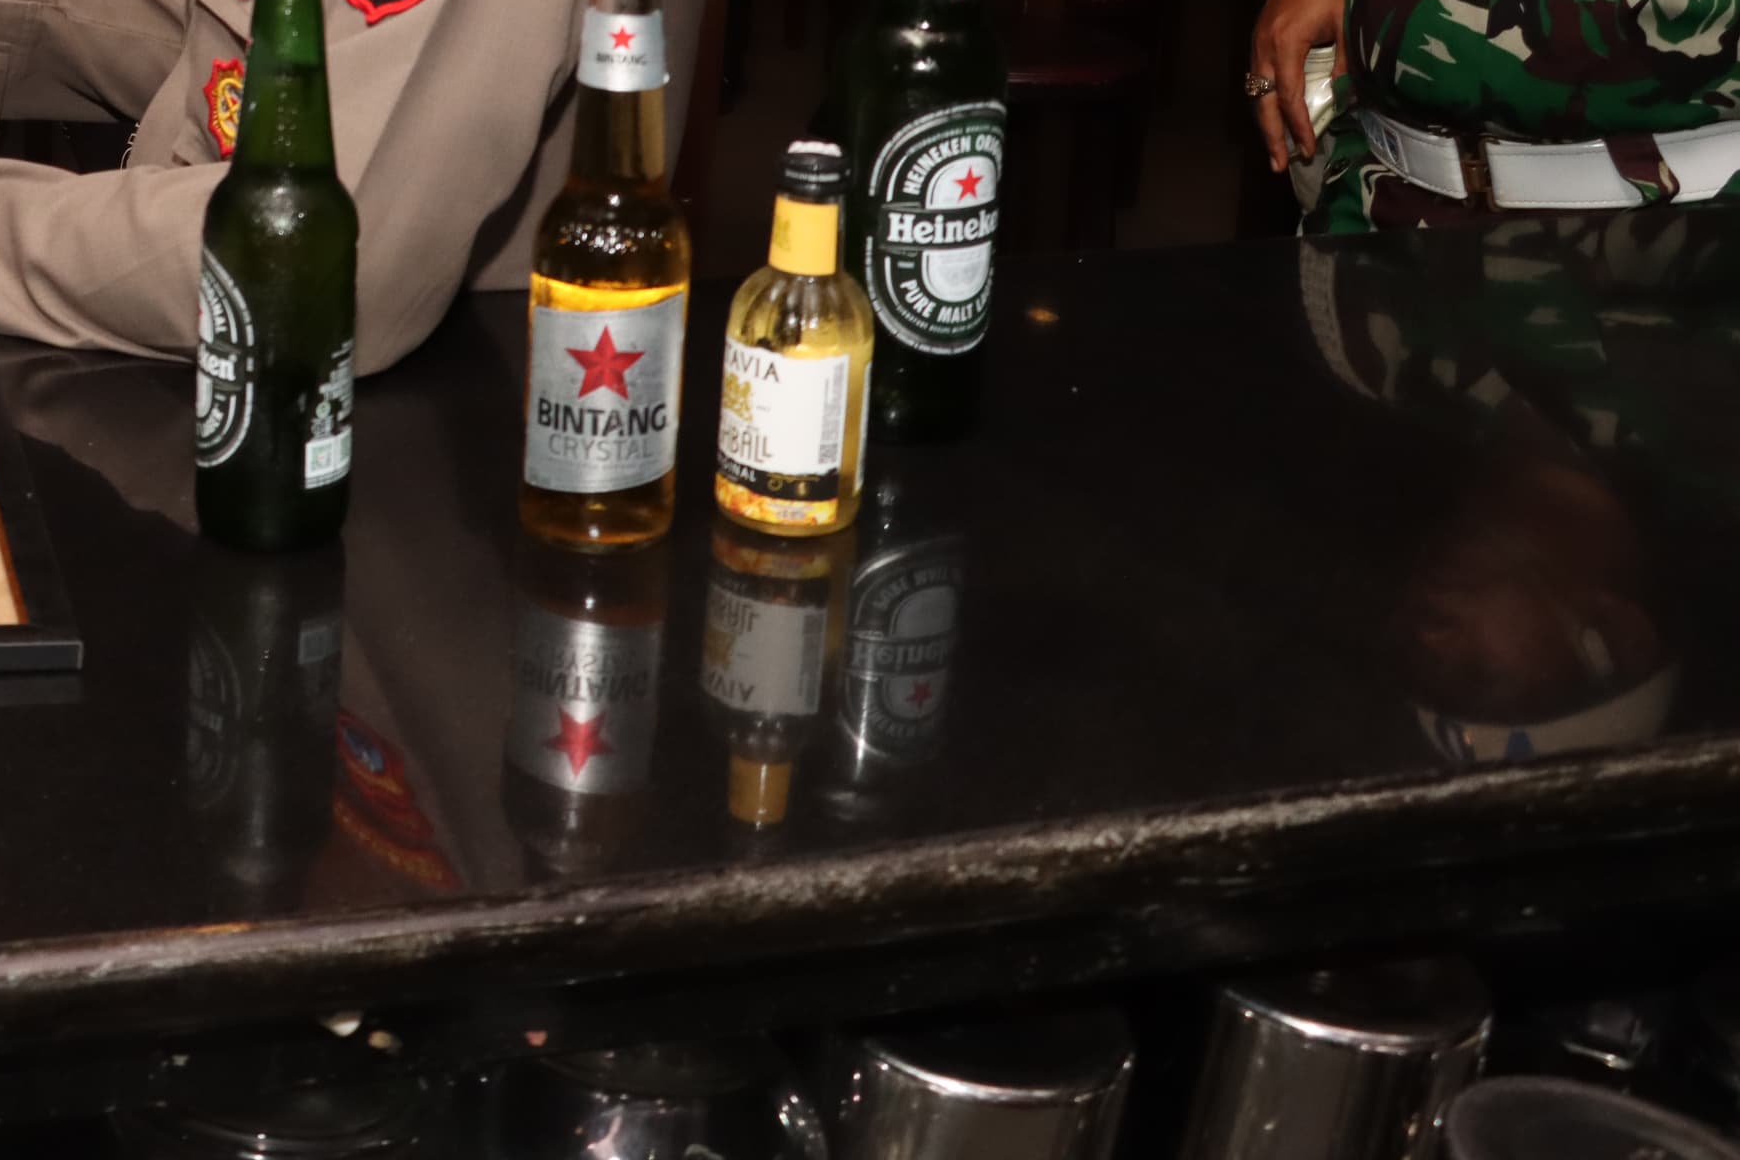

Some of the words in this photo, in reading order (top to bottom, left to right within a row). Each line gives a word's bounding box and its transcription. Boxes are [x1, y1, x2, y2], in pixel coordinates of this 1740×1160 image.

[902, 133, 972, 196] HEINEKEN
[900, 278, 937, 319] PURE
[937, 302, 974, 324] MALT
[537, 396, 667, 438] BINTANG
[547, 432, 654, 463] CRYSTAL
